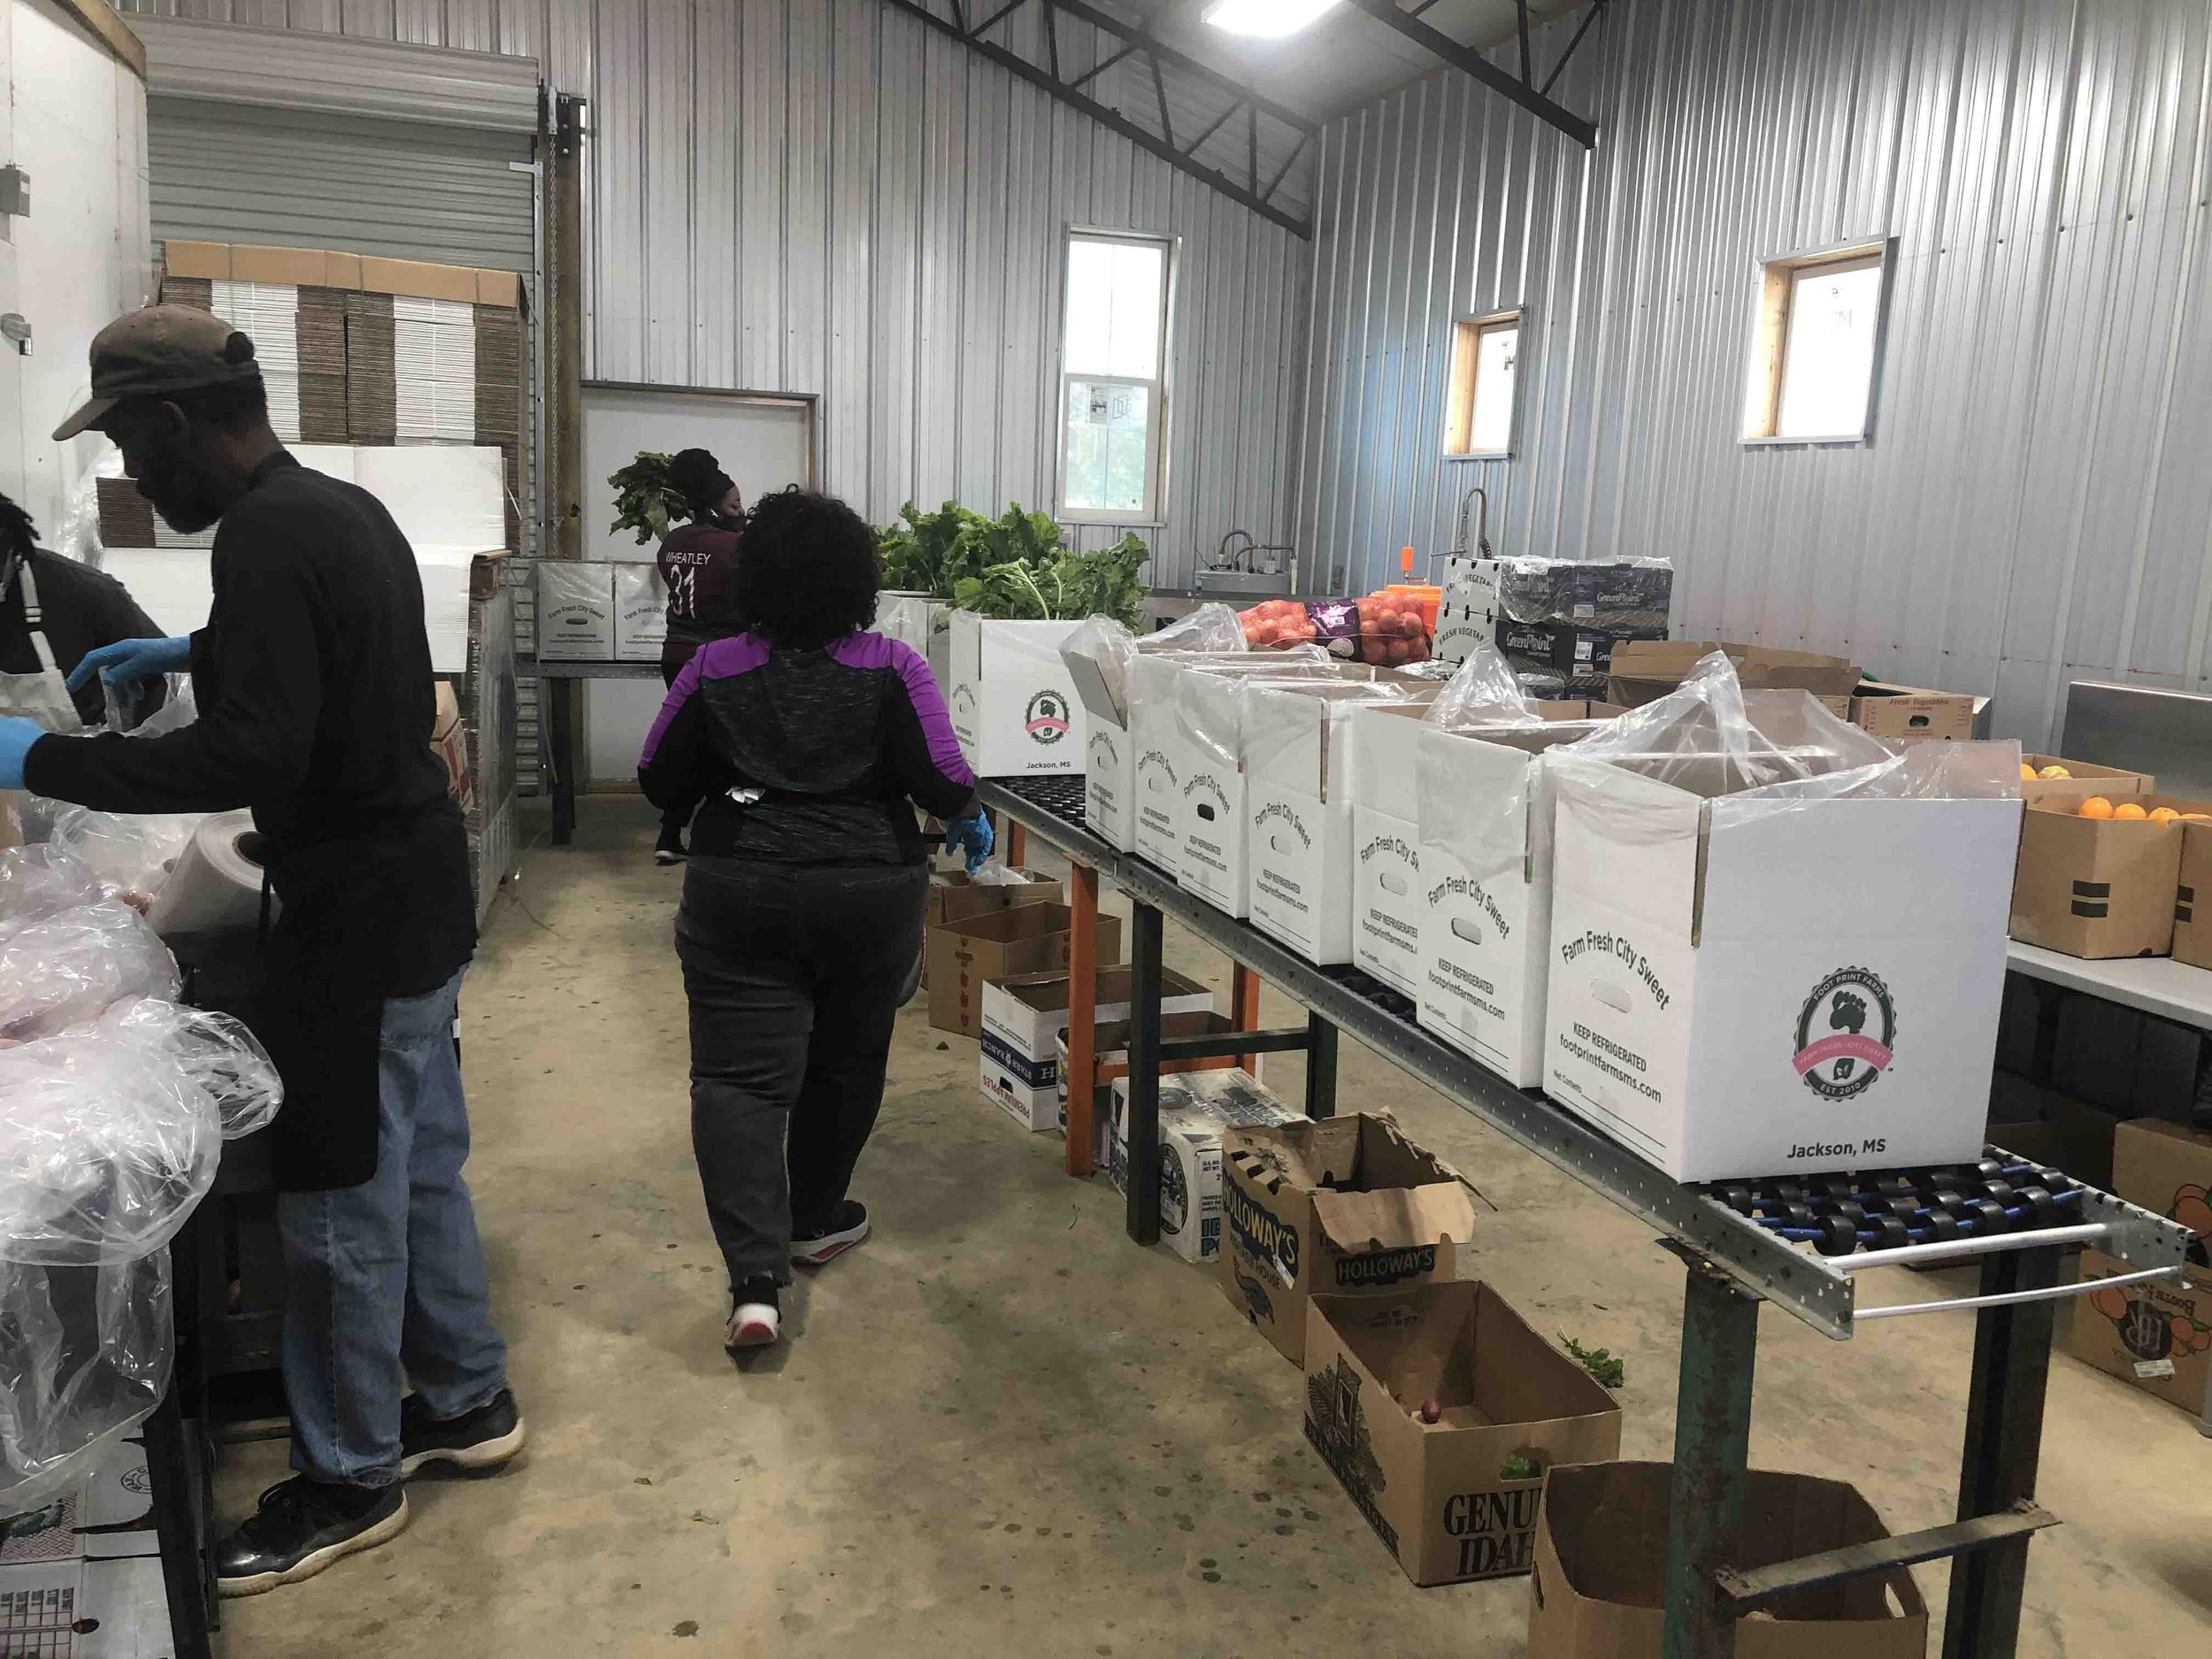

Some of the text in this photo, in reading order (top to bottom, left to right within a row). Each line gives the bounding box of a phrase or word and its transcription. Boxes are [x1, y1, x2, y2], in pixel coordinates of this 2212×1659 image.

[665, 551, 711, 565] WHEATLEY
[670, 564, 695, 619] 31
[1439, 627, 1457, 645] FRESH
[1506, 631, 1555, 651] GreenPoint
[1026, 761, 1058, 770] Jackson,
[1283, 803, 1294, 826] City
[1360, 842, 1376, 865] Farm
[1375, 834, 1394, 852] Fresh
[1394, 839, 1410, 863] City
[1428, 875, 1510, 941] Farm Fresh City Sweet
[1438, 956, 1494, 996] KEEP REFRIGERATED
[1562, 931, 1671, 1010] Farm Fresh City Sweet
[1428, 970, 1505, 1021] footprintfarmsms.com
[1814, 973, 1885, 1002] FOOT PRINT FARMS
[1573, 1021, 1647, 1072] KEEP REFRIGERATED
[1560, 1033, 1662, 1103] footprintfarmsms.com
[1819, 1083, 1862, 1095] EST 2010
[1787, 1138, 1886, 1159] Jackson, MS
[1224, 1175, 1296, 1265] HOLLOWAY'S
[1340, 1248, 1432, 1281] HOLLOWAY'S
